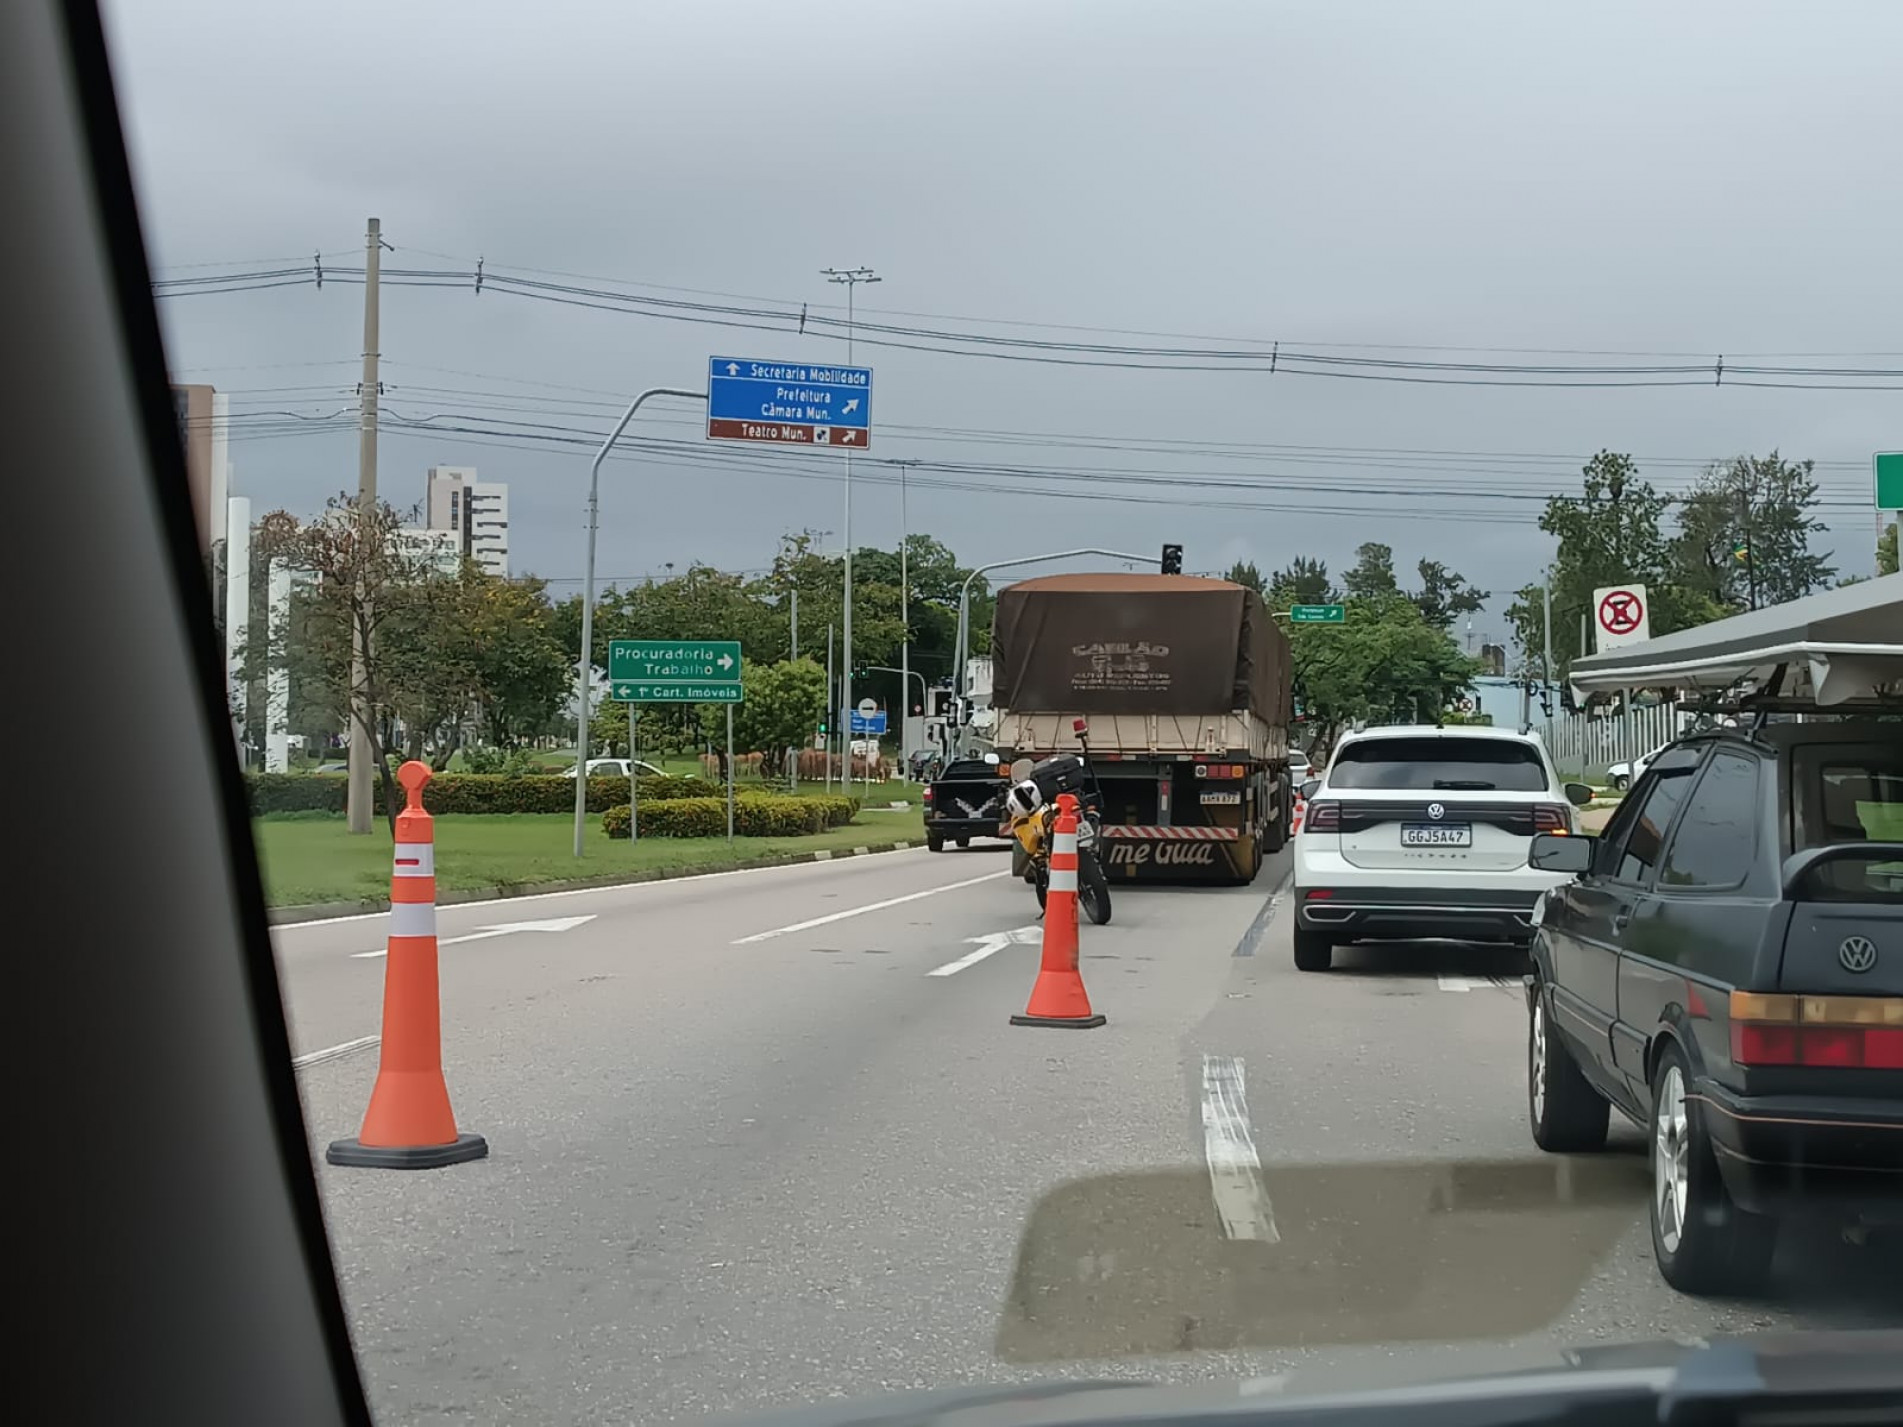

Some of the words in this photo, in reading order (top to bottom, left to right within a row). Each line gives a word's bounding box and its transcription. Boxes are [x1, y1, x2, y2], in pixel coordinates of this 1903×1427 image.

[750, 363, 806, 381] Secretaria
[809, 368, 867, 385] Mobilidade
[776, 387, 831, 404] Prefeitura
[761, 402, 803, 418] Câmara
[806, 407, 832, 421] Mun.
[741, 423, 778, 438] Teatro
[781, 426, 807, 441] Mun.
[615, 647, 714, 660] Procuradoria
[644, 663, 714, 676] Trabalho
[653, 687, 684, 698] Cart.
[687, 686, 737, 698] Imóveis
[1407, 830, 1464, 843] GGJ5A47
